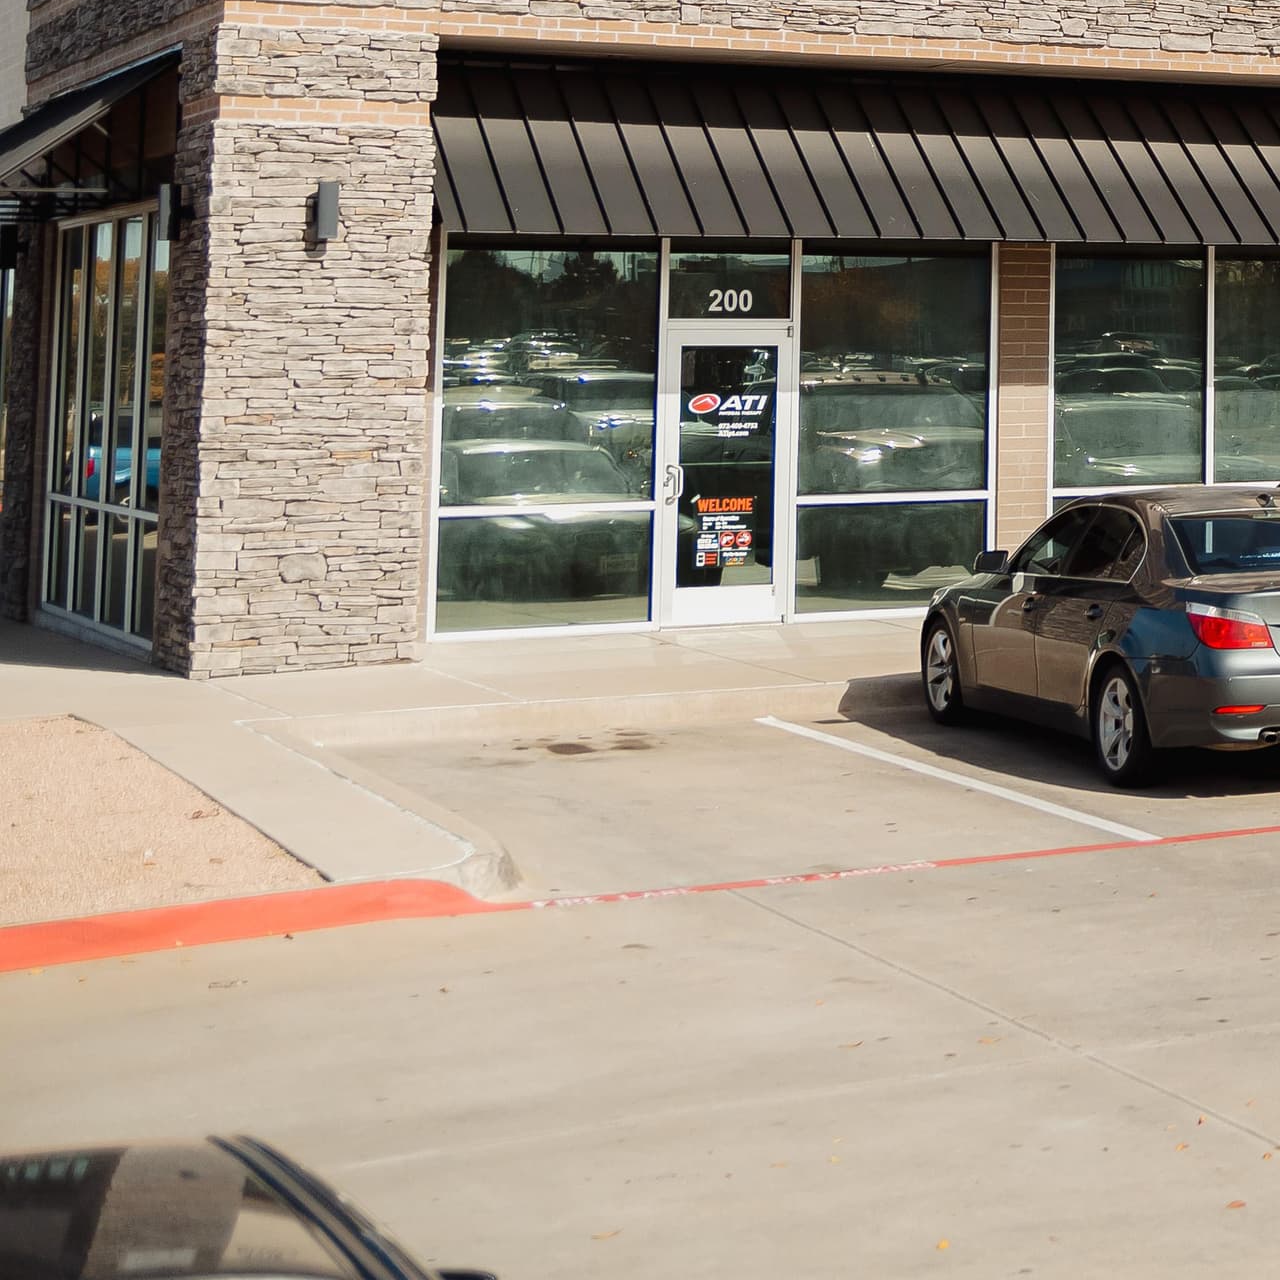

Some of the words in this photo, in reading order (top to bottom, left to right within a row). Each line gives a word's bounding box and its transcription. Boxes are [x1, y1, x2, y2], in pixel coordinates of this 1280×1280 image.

[708, 288, 754, 312] 200
[719, 395, 768, 410] ATI
[697, 497, 753, 512] WELCOME
